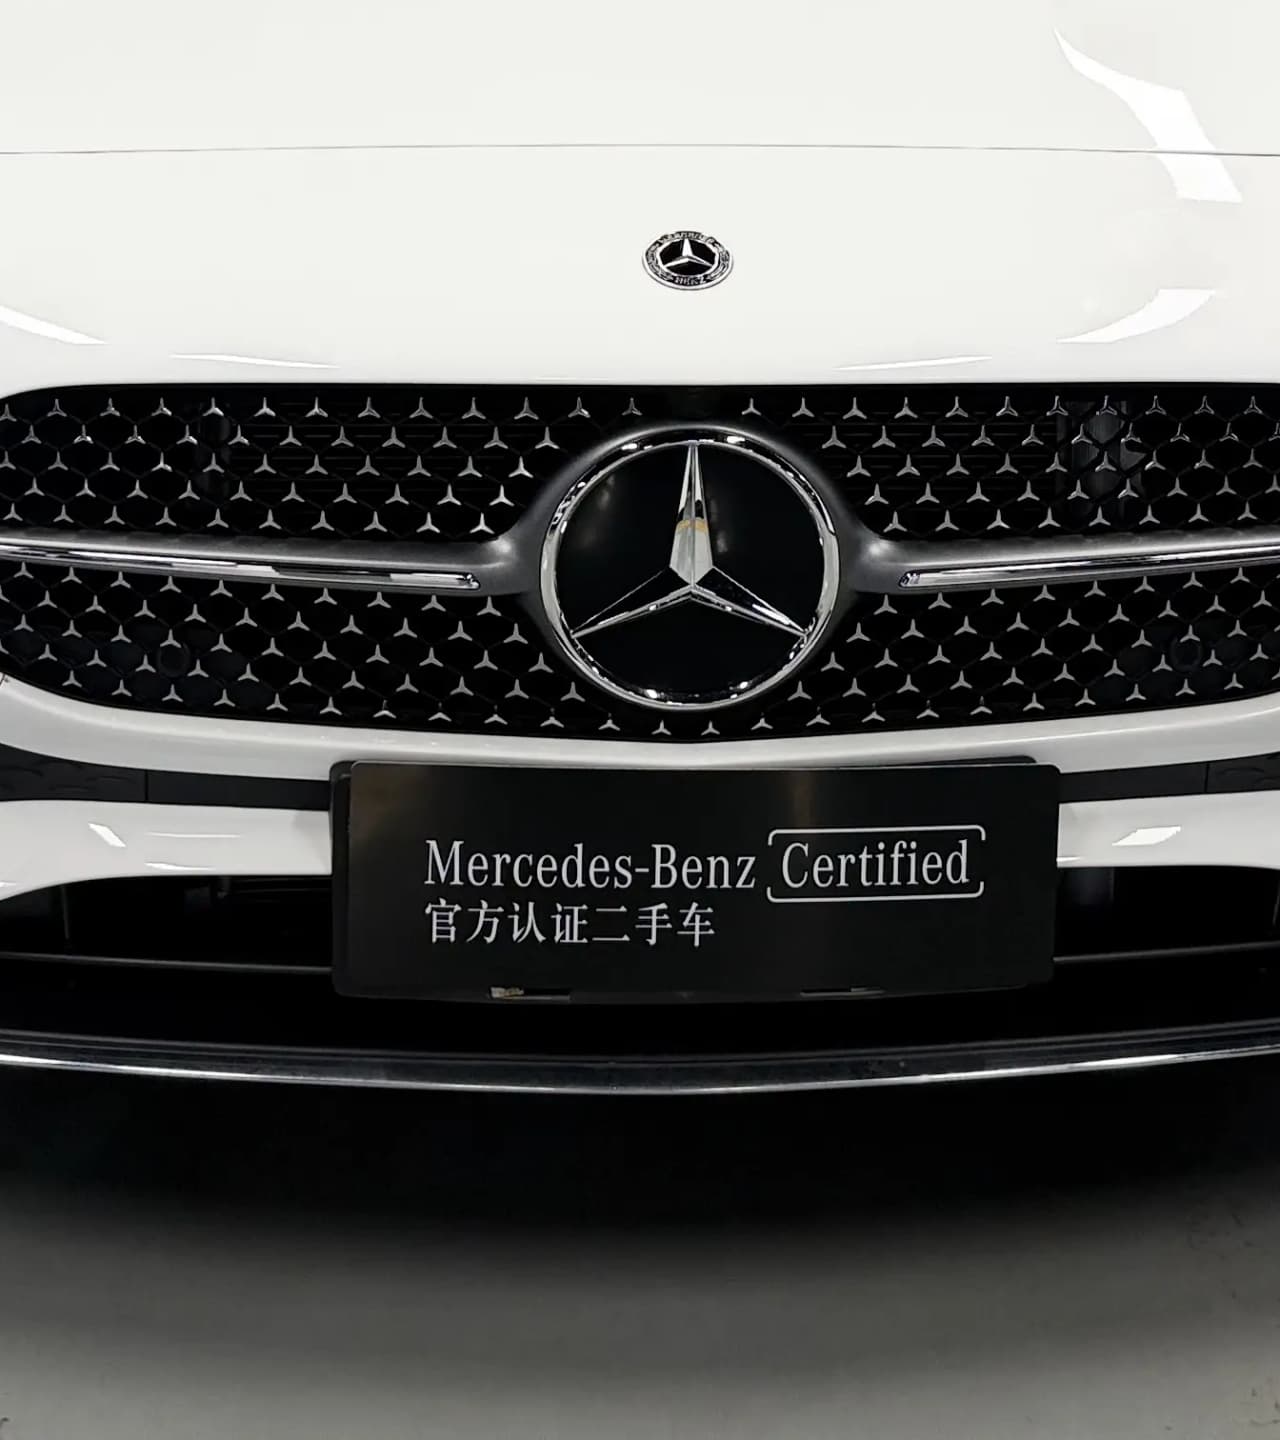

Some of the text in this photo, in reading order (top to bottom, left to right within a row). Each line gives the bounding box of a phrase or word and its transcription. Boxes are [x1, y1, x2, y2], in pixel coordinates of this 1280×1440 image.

[425, 839, 969, 889] Mercedes-Benz Certified
[425, 898, 715, 947] 官方认证二手车
